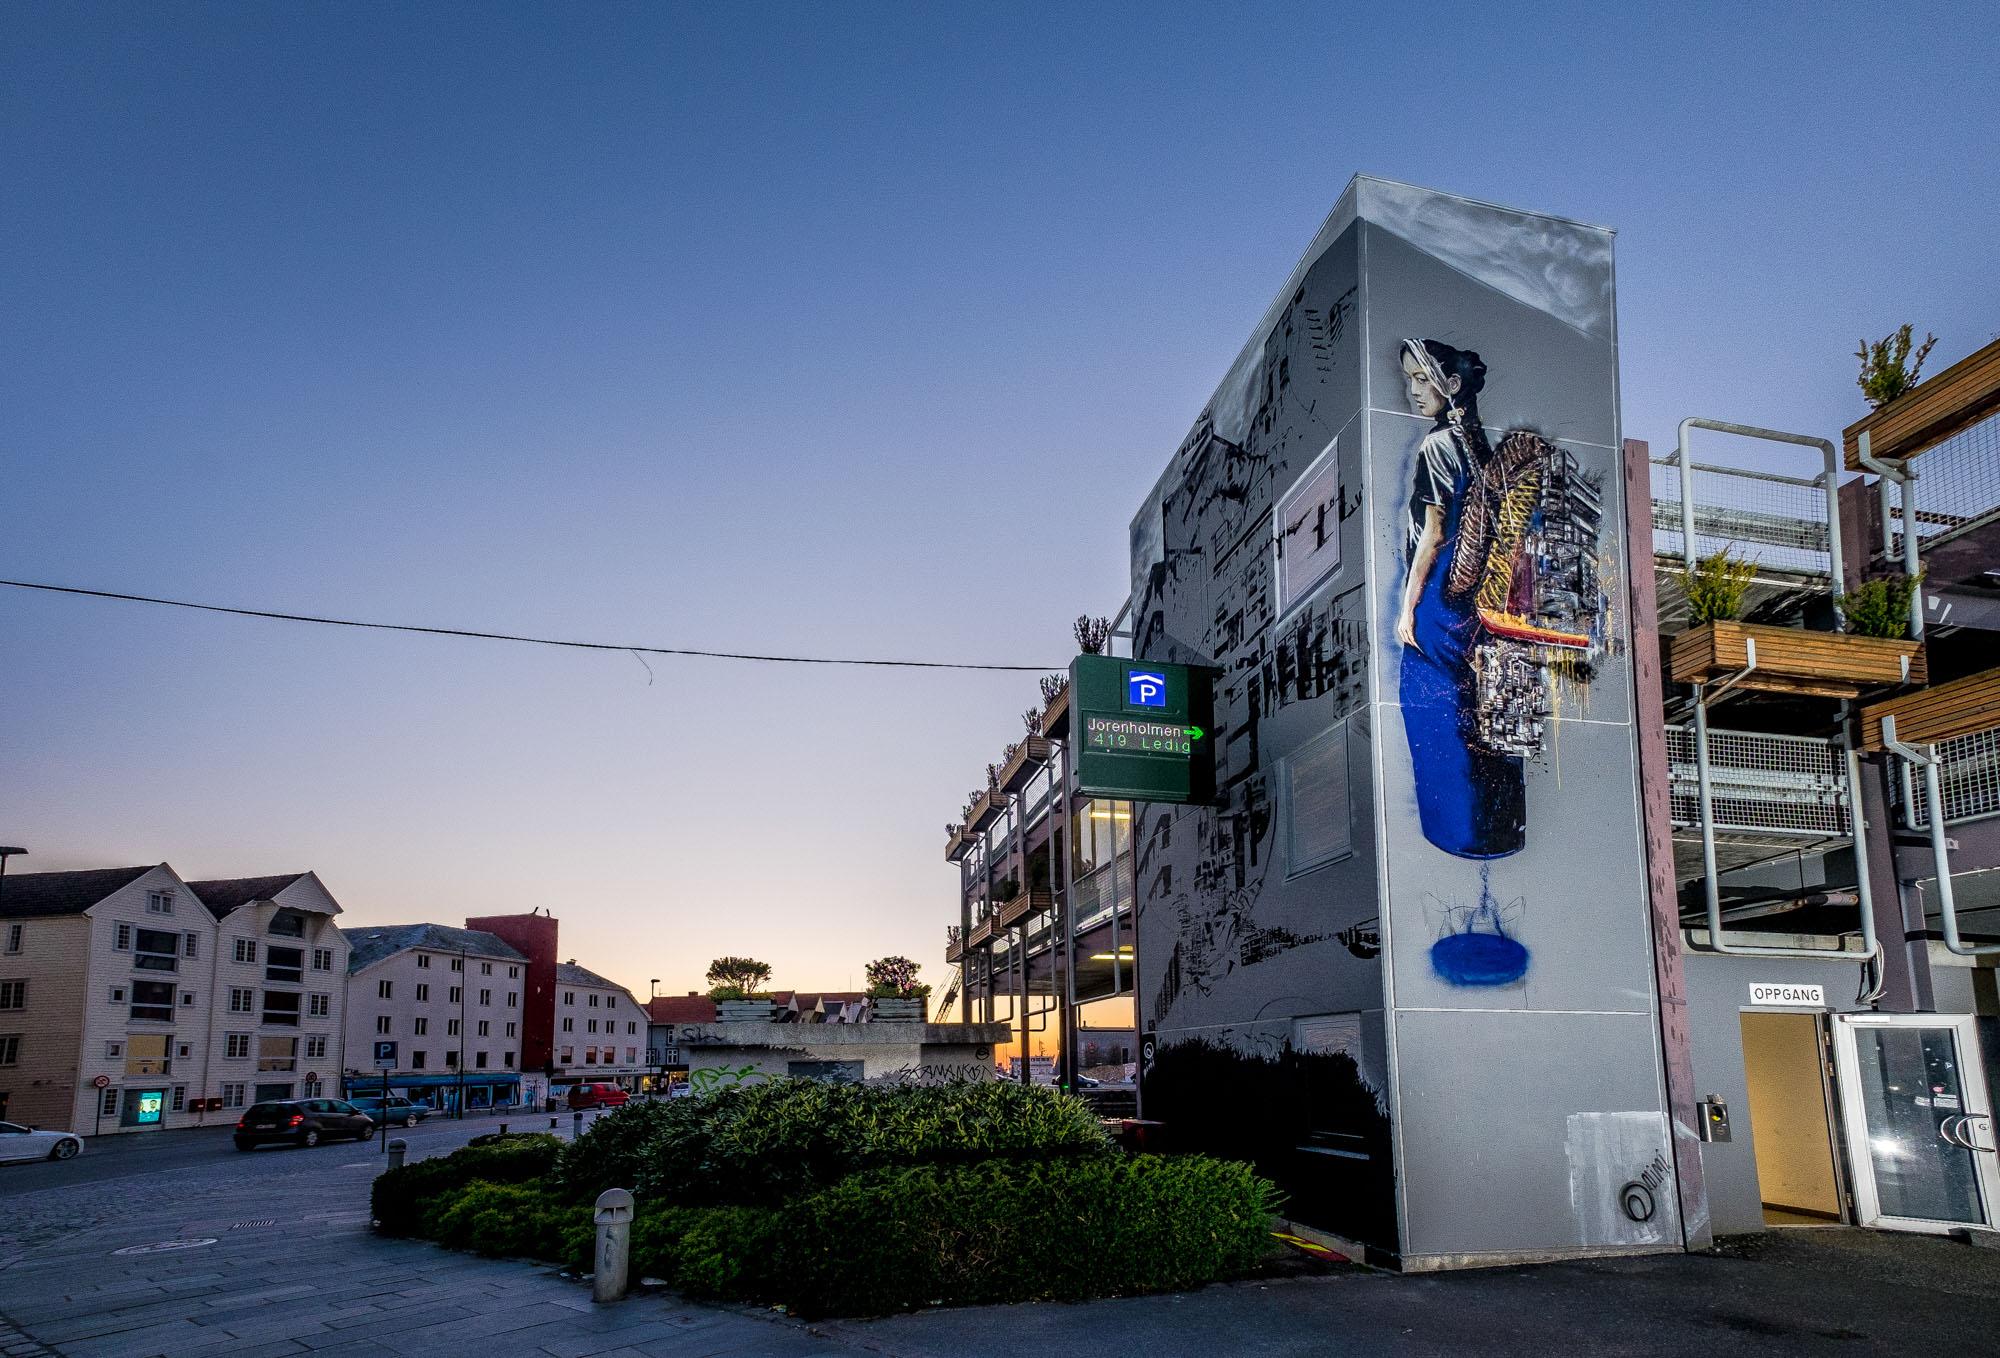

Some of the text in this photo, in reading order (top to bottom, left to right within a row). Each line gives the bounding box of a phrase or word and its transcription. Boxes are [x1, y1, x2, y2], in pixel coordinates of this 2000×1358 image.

[1140, 685, 1157, 703] P
[1088, 718, 1181, 737] Jorenholmen
[1094, 733, 1191, 753] 419 Ledig
[1754, 987, 1820, 1001] OPPGANG
[380, 1043, 392, 1057] P
